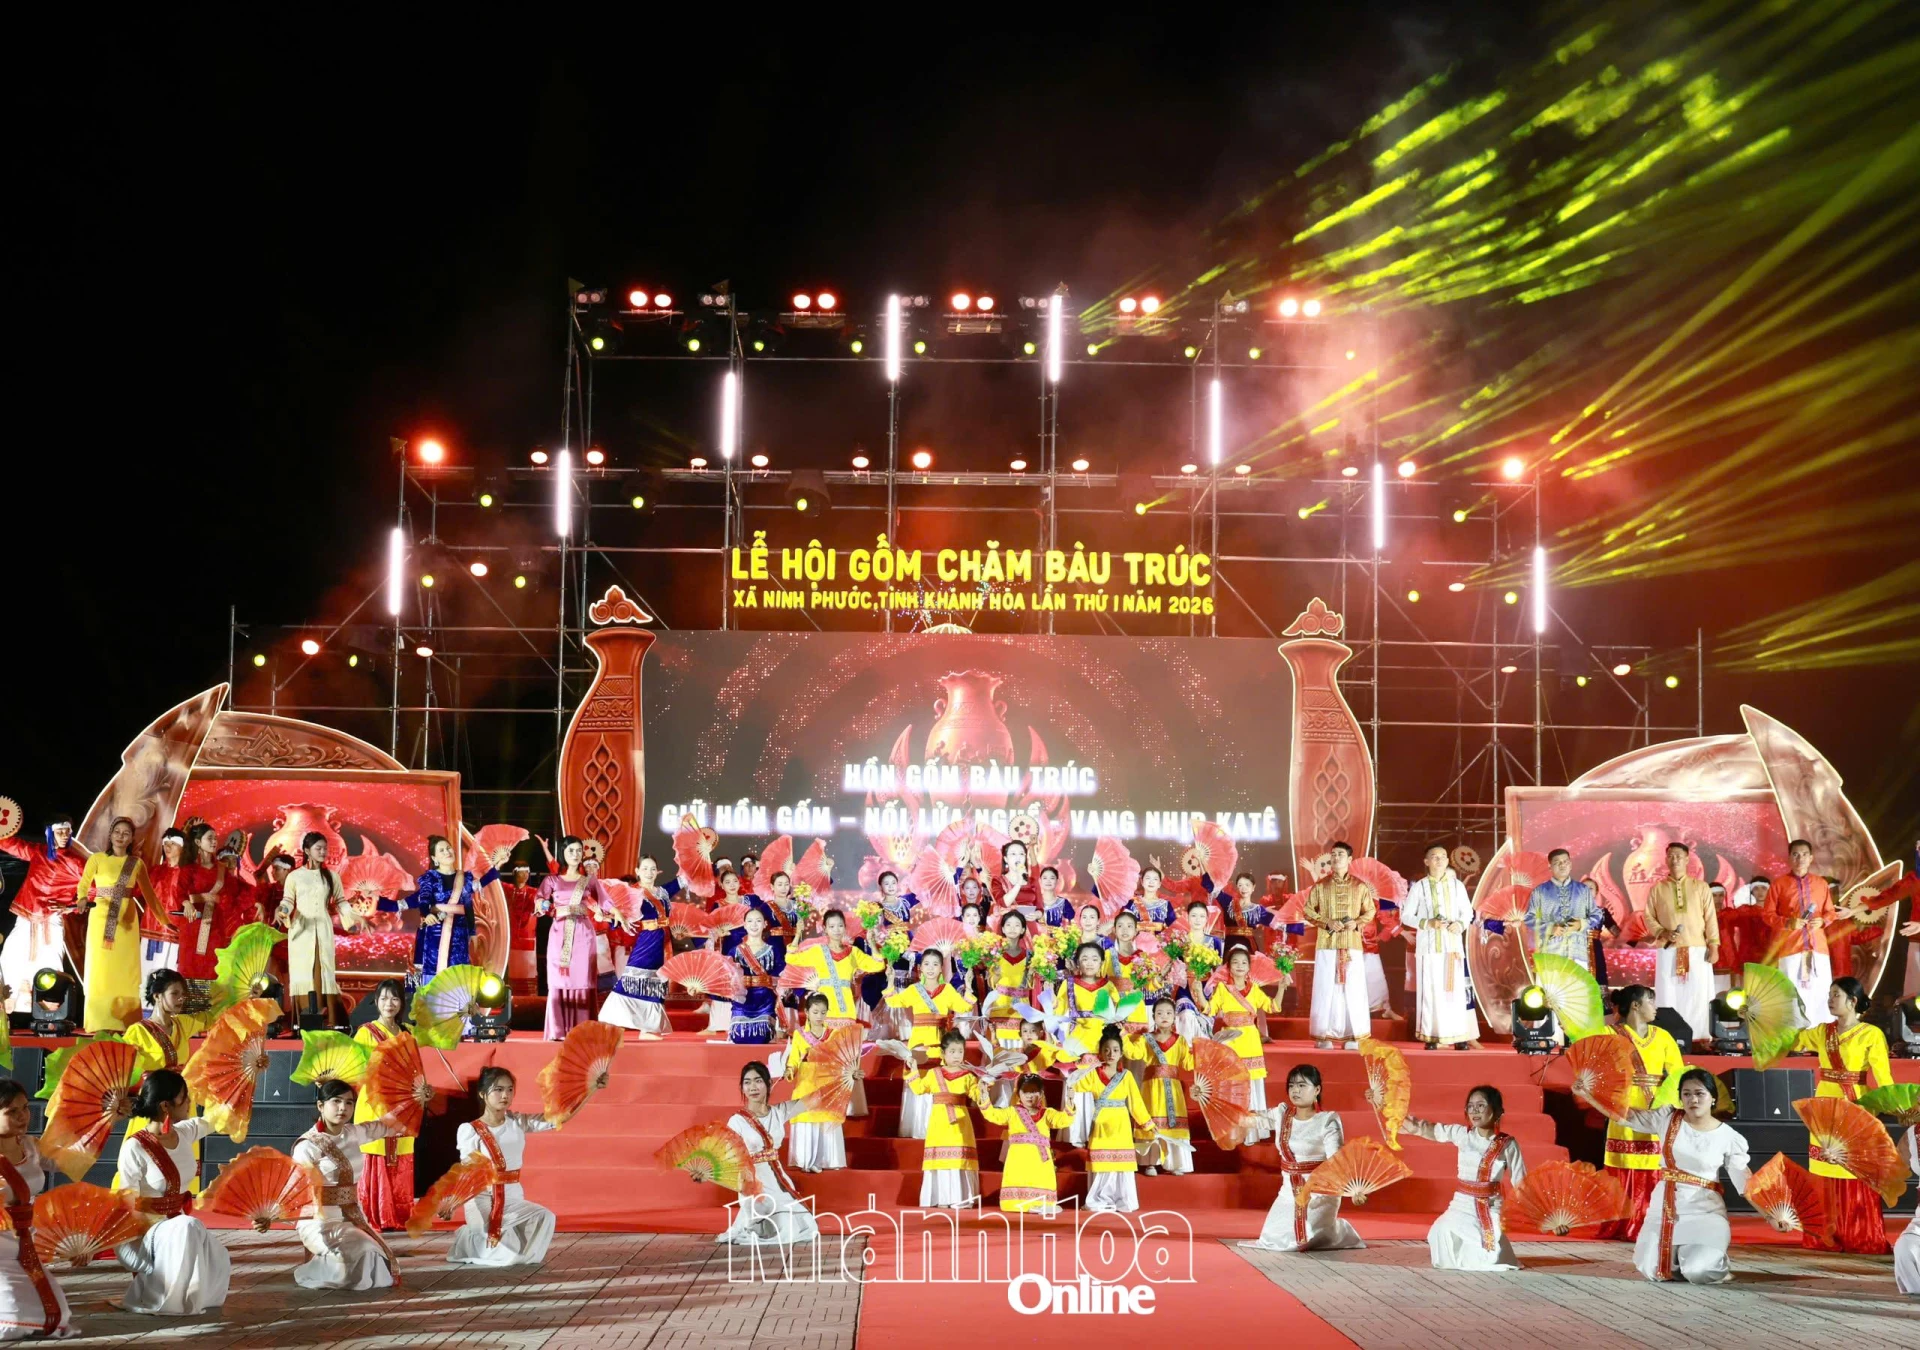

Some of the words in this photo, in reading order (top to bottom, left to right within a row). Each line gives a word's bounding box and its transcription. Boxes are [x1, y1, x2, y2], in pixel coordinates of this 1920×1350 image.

[731, 530, 769, 581] LỄ
[782, 539, 836, 590] HỘI
[849, 533, 922, 582] GỐM
[937, 540, 1032, 583] CHĂM
[1045, 541, 1111, 585] BÀU
[1123, 544, 1211, 587] TRÚC
[733, 585, 757, 608] XÃ
[763, 591, 805, 609] NINH
[1073, 588, 1109, 612] THỨ
[1123, 589, 1161, 613] NĂM
[1168, 596, 1214, 615] 2026
[845, 756, 895, 789] HỒN
[906, 757, 960, 790] GỐM
[970, 759, 1020, 791] BÀU
[1030, 760, 1096, 792] TRÚC
[716, 797, 767, 831] HỒN
[776, 798, 831, 832] GỐM
[864, 799, 908, 833] NỐI
[1071, 809, 1136, 836] VANG
[1215, 806, 1277, 838] KATÊ
